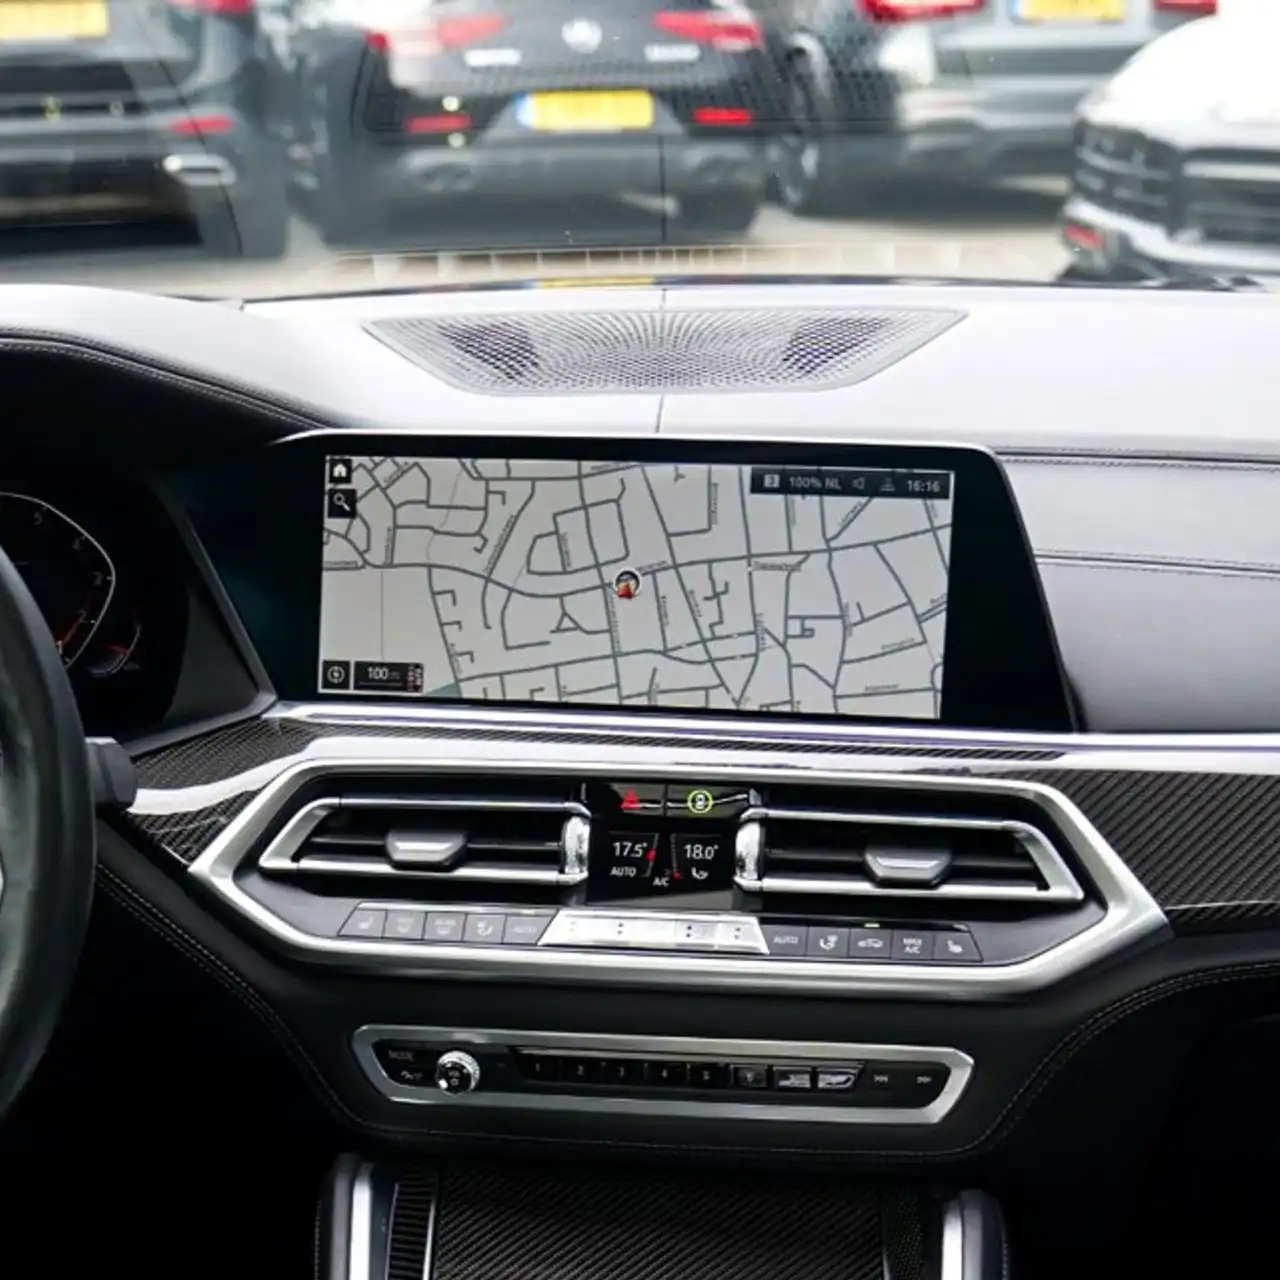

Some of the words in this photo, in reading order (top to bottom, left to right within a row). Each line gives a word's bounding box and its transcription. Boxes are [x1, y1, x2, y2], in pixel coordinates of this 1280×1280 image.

[789, 476, 821, 488] 100%
[825, 478, 841, 489] NL
[907, 480, 940, 492] 16:16
[367, 666, 389, 680] 100
[610, 866, 637, 877] AUTO
